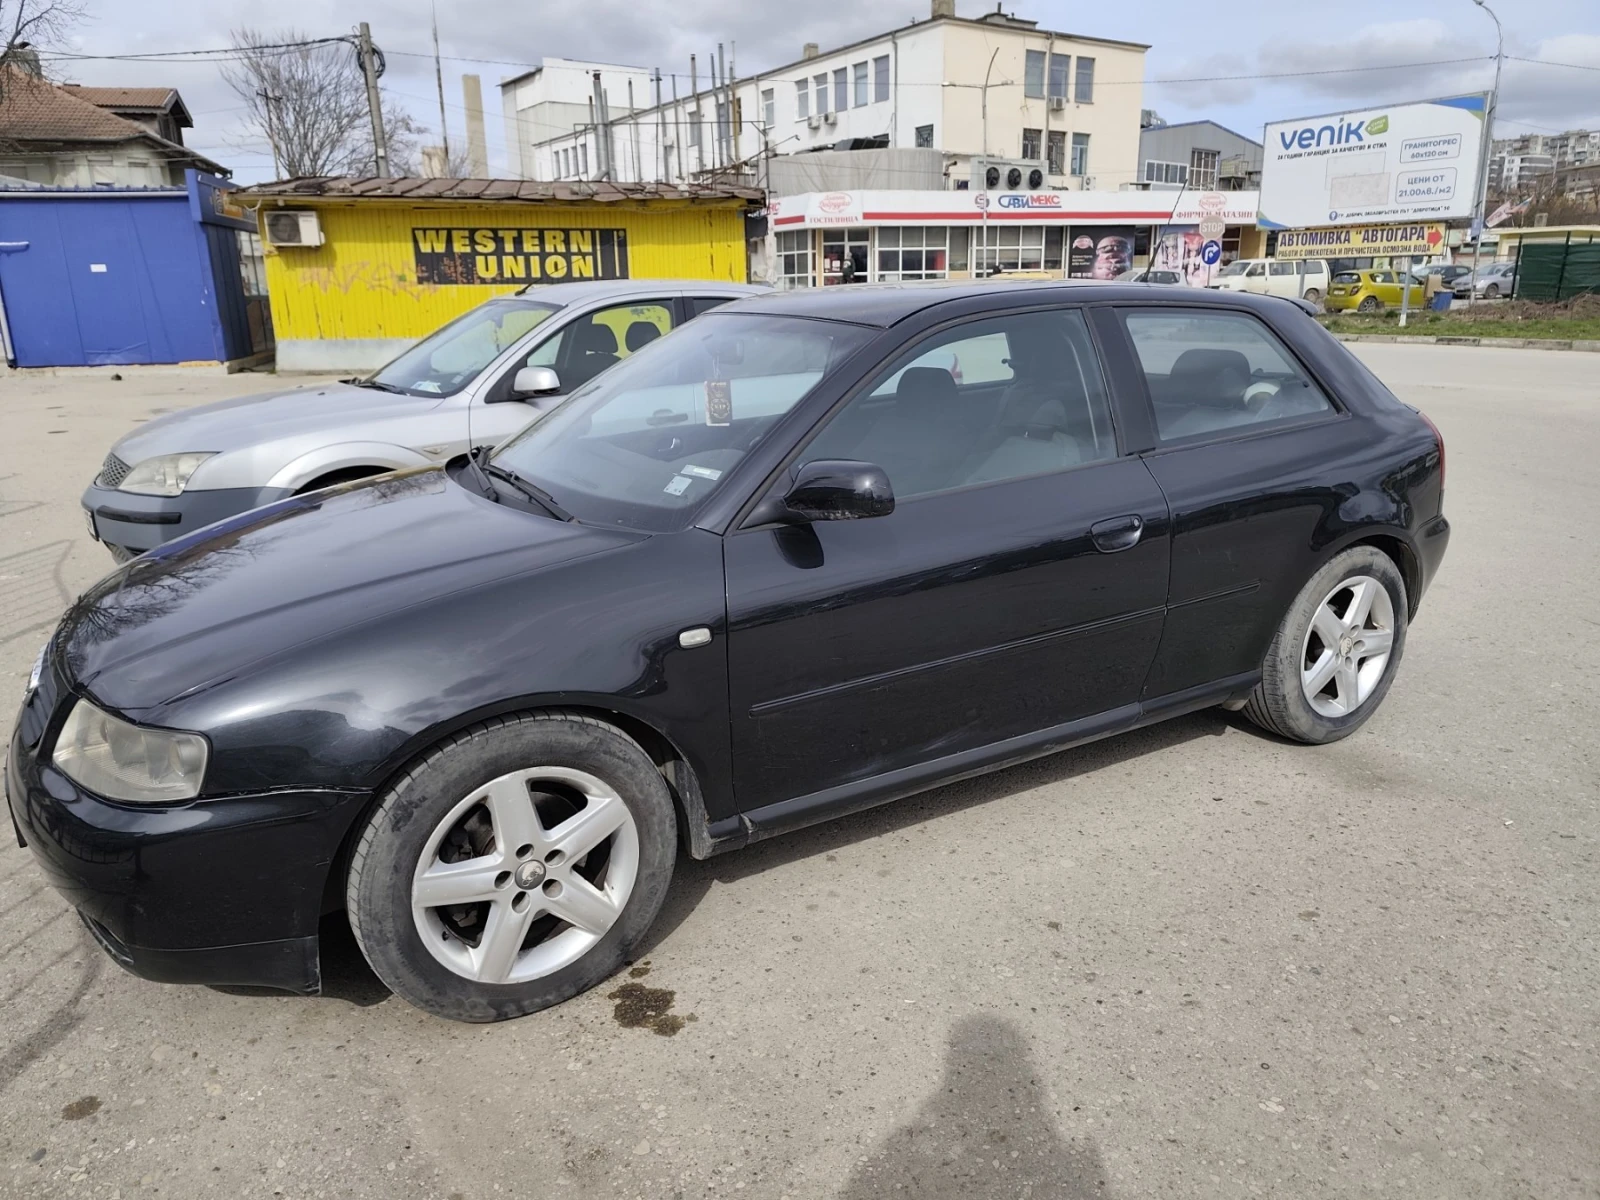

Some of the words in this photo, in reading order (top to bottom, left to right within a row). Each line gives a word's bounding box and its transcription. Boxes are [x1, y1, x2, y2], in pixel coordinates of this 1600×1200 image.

[1280, 117, 1365, 150] venik
[1404, 138, 1458, 150] ГРАНИТОГРЕС
[1284, 152, 1303, 160] ГОДИНИ
[1304, 148, 1331, 158] ГАРАНЦИЯ
[1339, 145, 1366, 153] КАЧЕСТВО
[1407, 176, 1431, 185] ЦЕНИ
[1432, 175, 1445, 183] ОТ
[809, 216, 859, 224] ГОСТИЛНИЦА
[1202, 223, 1223, 233] STOP
[414, 230, 592, 253] WESTERN
[1279, 230, 1350, 247] АВТОМИВКА
[1278, 248, 1299, 258] РАБОТИ
[1300, 248, 1304, 256] С
[1304, 247, 1337, 256] ОМЕКОТЕНА
[1338, 247, 1342, 255] И
[1343, 246, 1381, 255] ПРЕЧИСТЕНА
[1382, 245, 1411, 254] ОСМОЗНА
[1413, 244, 1431, 252] ВОДА
[475, 255, 594, 278] UNION
